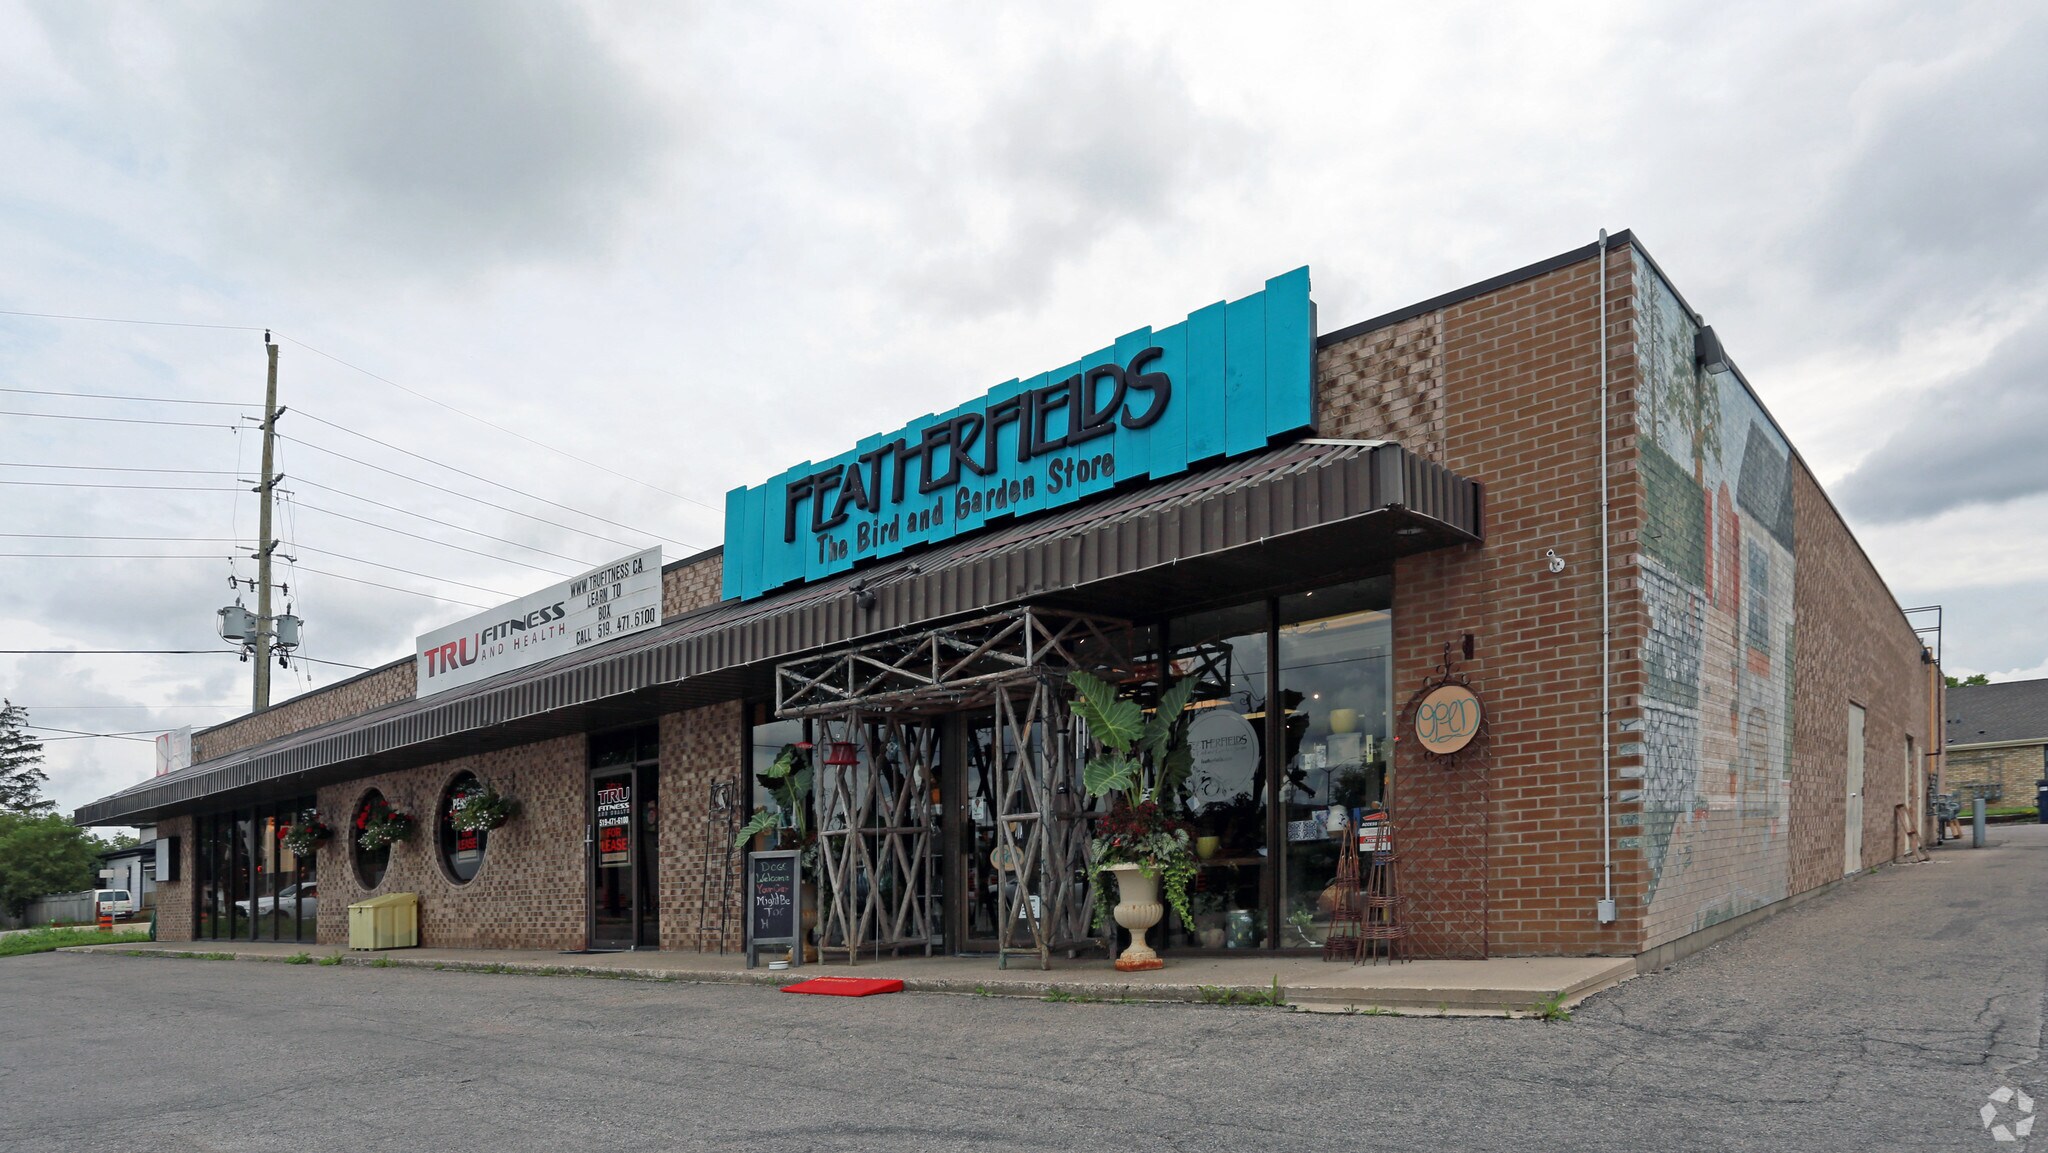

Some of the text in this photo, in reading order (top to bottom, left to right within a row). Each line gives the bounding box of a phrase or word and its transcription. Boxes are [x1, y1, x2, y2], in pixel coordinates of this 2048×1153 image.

[784, 346, 1172, 543] FEATHERFIELDS
[817, 452, 1115, 564] The Bird and Garden Store
[570, 557, 643, 599] WWW TRUFITNESS CA
[587, 582, 622, 608] LEARN TO
[598, 603, 611, 621] BOX
[424, 601, 566, 678] TRU FITNESS
[481, 622, 566, 661] AND HEALTH
[576, 627, 592, 645] CALL
[598, 787, 630, 805] TRU
[598, 802, 630, 812] FITNESS
[606, 828, 621, 838] FOR
[458, 837, 477, 851] LEASE
[601, 839, 627, 852] LEASE
[779, 894, 791, 905] Be
